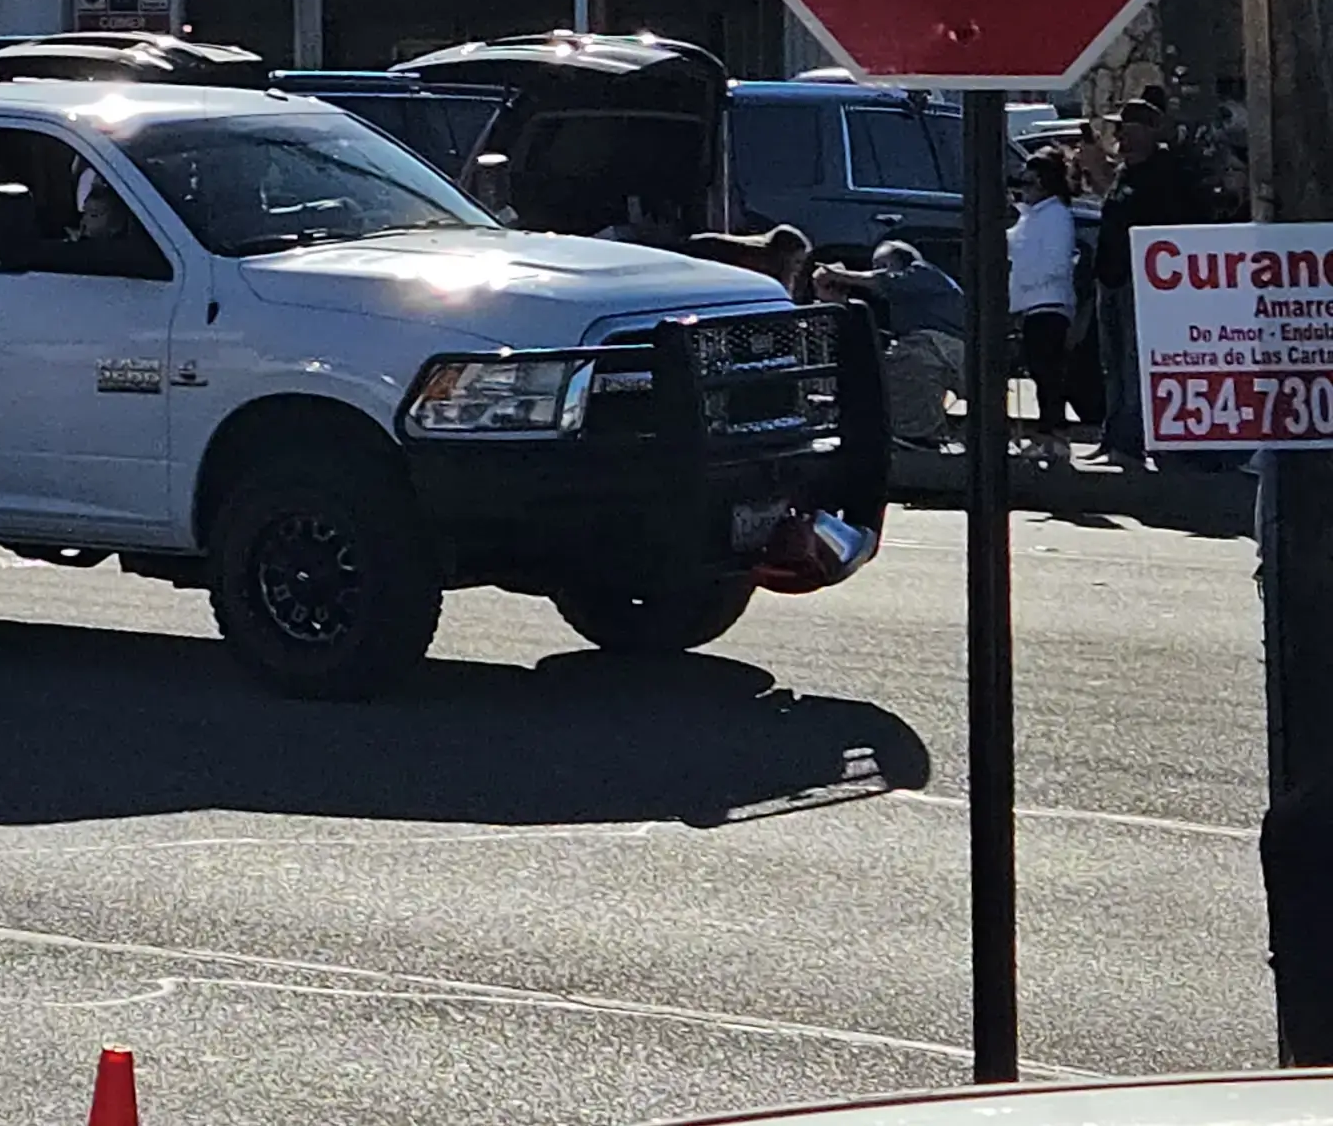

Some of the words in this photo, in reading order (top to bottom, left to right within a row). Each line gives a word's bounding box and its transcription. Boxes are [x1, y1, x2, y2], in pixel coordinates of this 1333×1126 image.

[1218, 324, 1264, 343] Amor
[1150, 349, 1219, 366] Lectura
[1224, 348, 1245, 366] de
[1251, 346, 1283, 365] Las
[1156, 375, 1333, 435] 254-730
